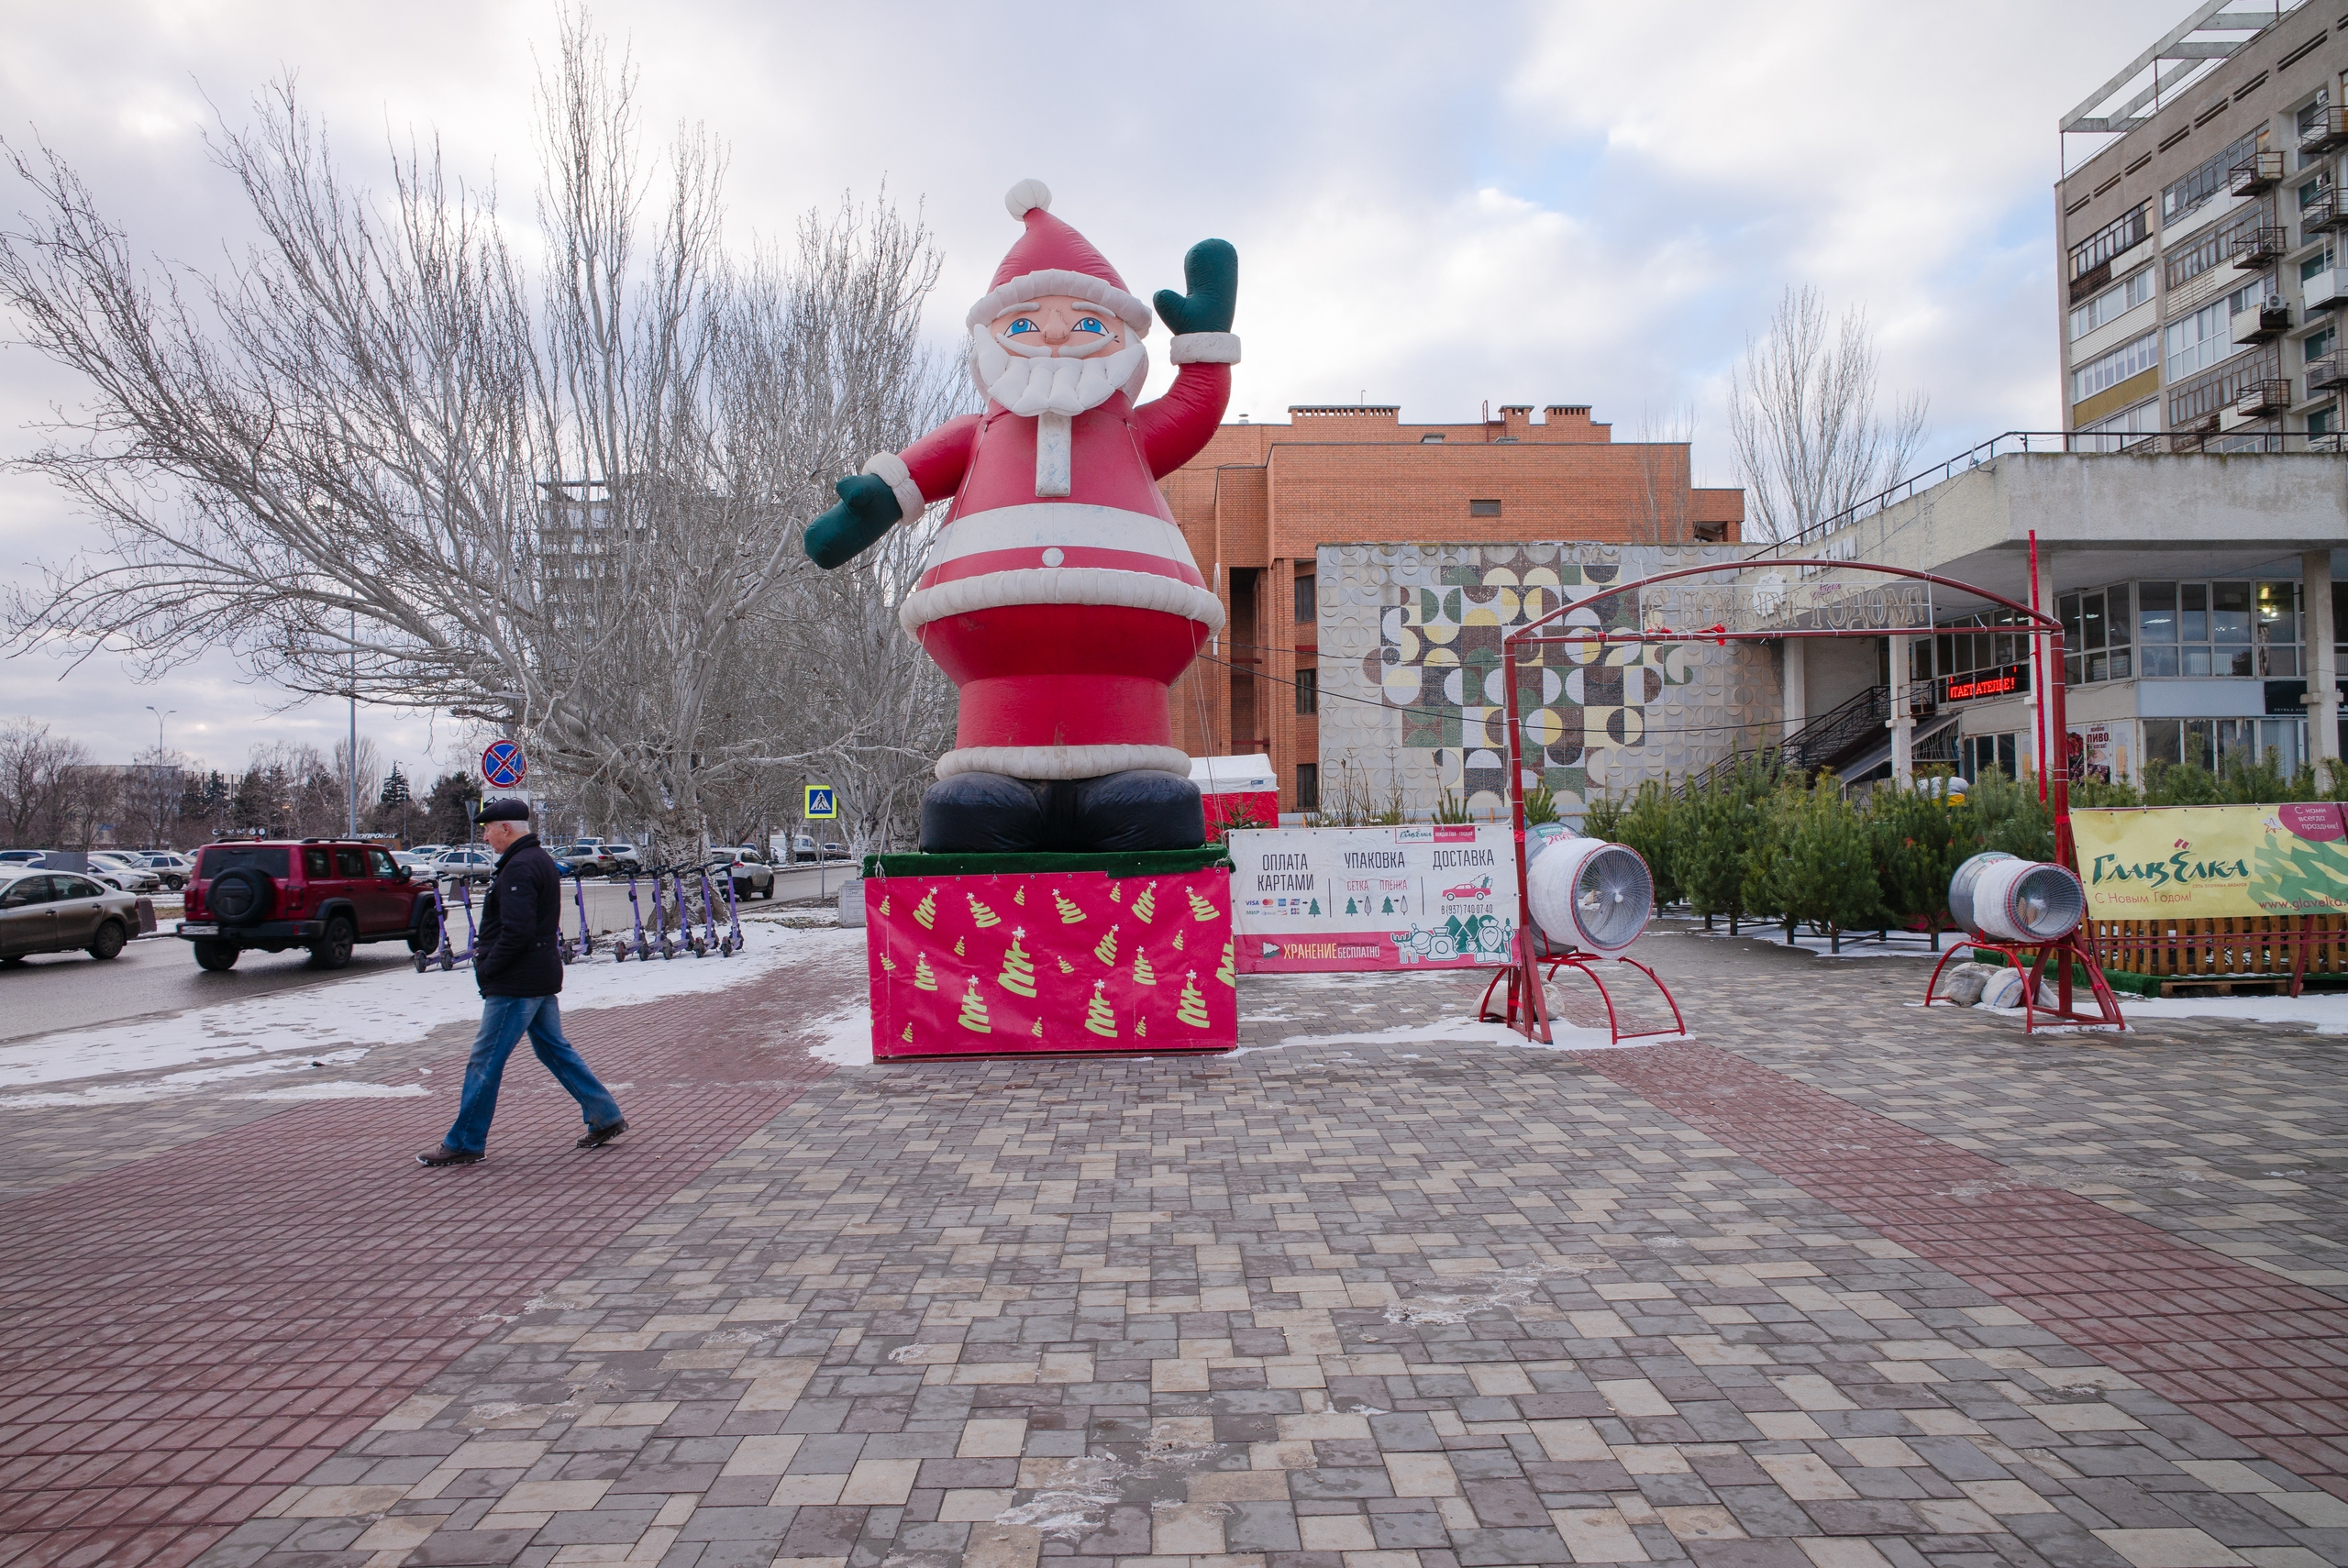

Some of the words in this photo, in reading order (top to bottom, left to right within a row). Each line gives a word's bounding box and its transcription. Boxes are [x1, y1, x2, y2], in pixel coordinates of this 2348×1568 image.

[1810, 586, 1924, 631] ГОДОМ!
[2087, 732, 2110, 744] ПИВО
[2294, 806, 2303, 814] С
[2301, 823, 2339, 832] праздник!
[1262, 853, 1309, 871] ОПЛАТА
[1344, 851, 1406, 869] УПАКОВКА
[1433, 848, 1495, 870] ДОСТАВКА
[1257, 873, 1314, 891] КАРТАМИ
[1346, 880, 1369, 891] СЕТКА
[1379, 878, 1408, 890] ПЛЁНКА
[2094, 892, 2105, 904] С
[2109, 892, 2150, 904] Новым
[2154, 890, 2193, 903] Годом!
[1283, 943, 1337, 960] ХРАНЕНИЕ
[1337, 945, 1380, 959] БЕСПЛАТНО
